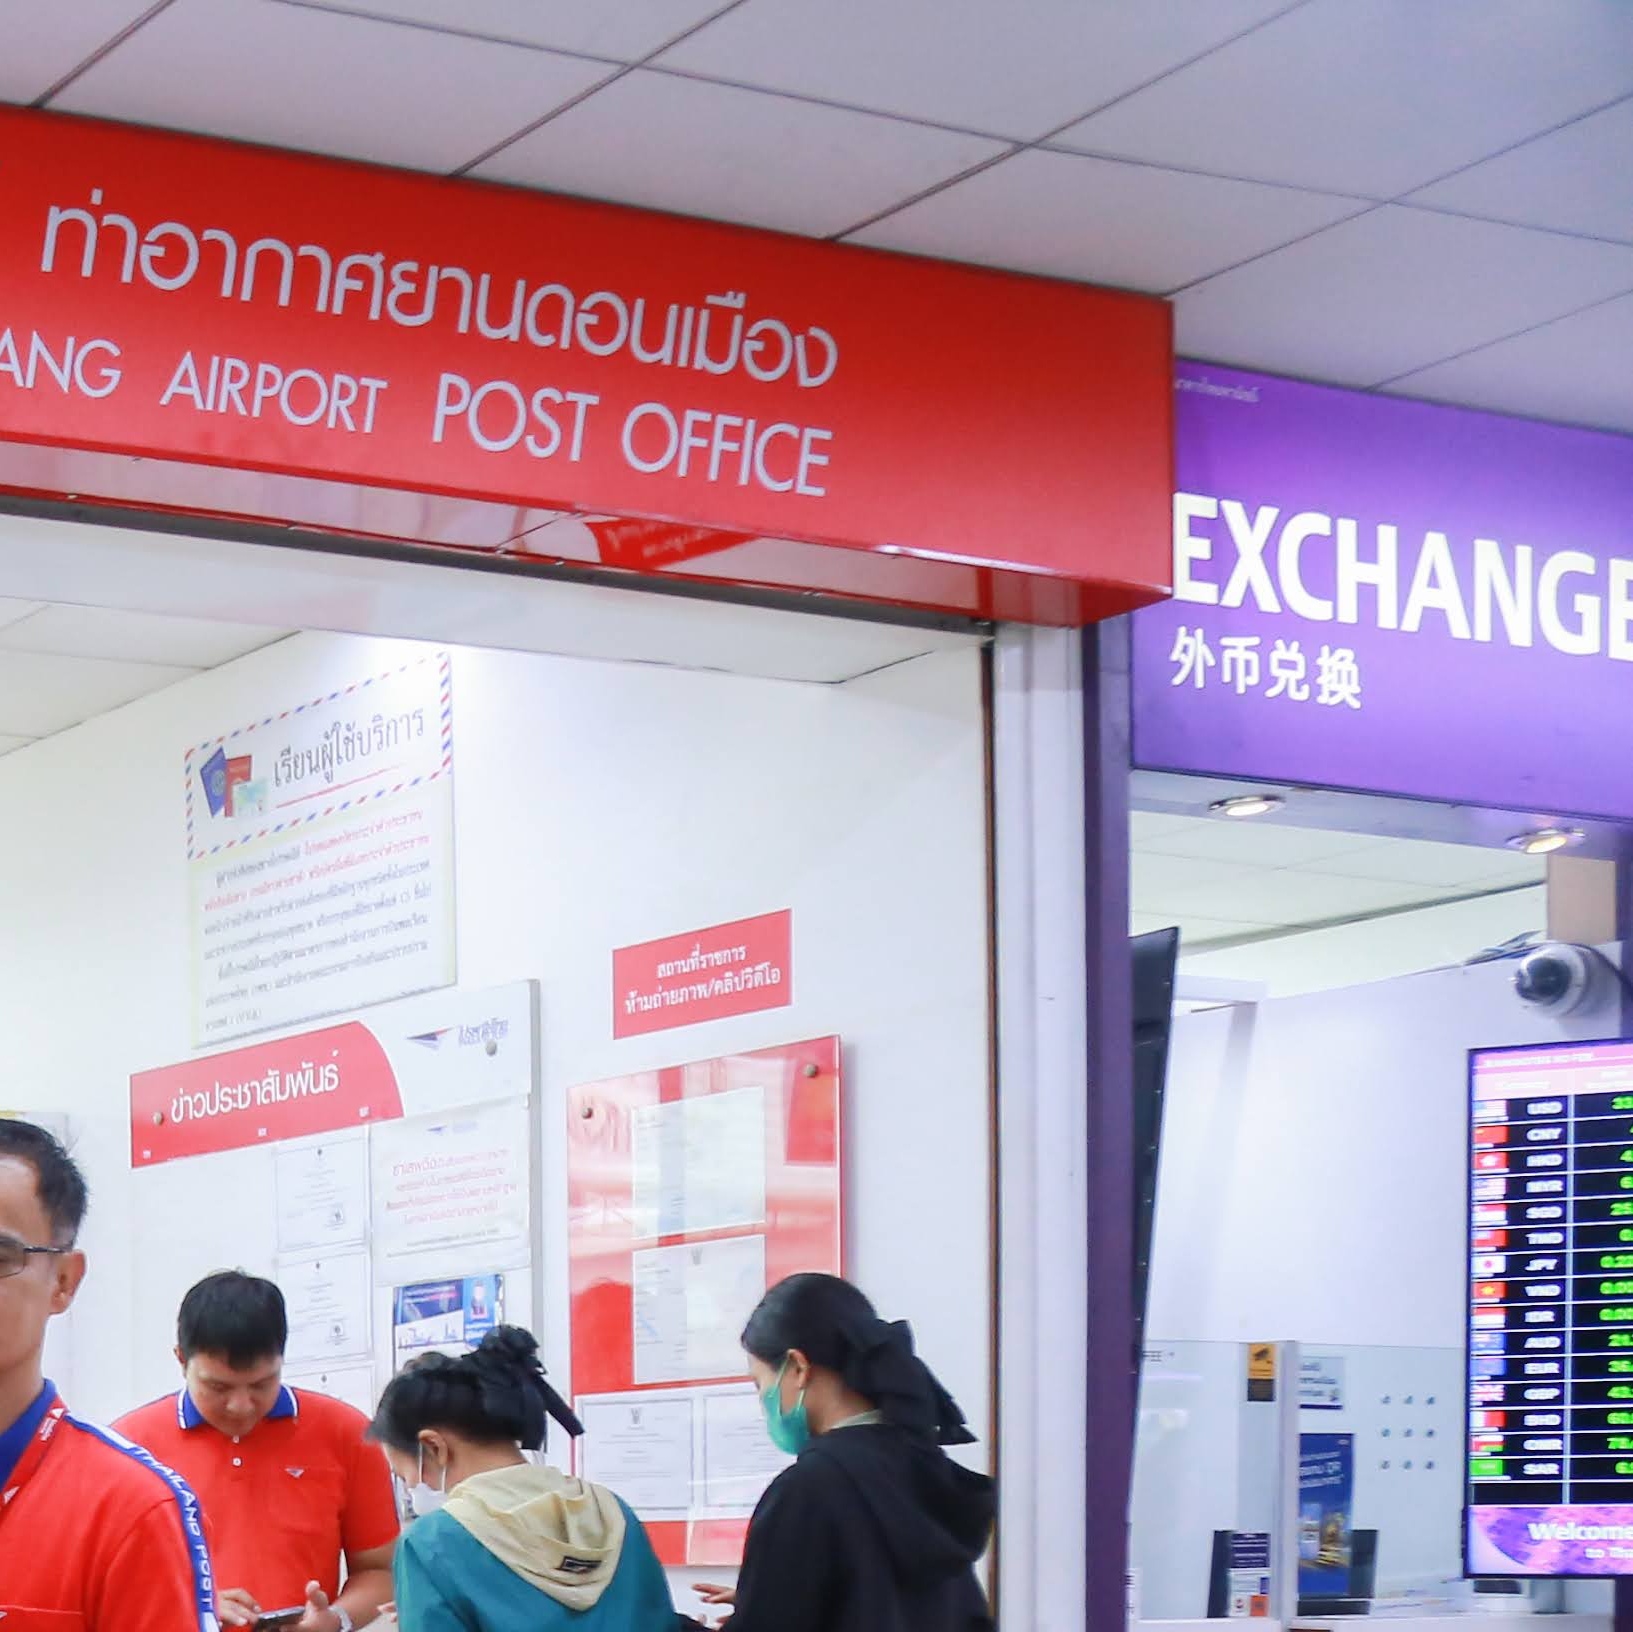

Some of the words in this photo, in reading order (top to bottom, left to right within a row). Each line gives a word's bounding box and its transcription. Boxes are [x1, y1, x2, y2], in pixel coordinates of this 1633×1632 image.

[41, 188, 838, 390] ท่าอากาศยานดอนเมือง
[159, 351, 388, 434] AIRPORT
[432, 373, 600, 463] POST
[621, 402, 833, 498] OFFICE
[1169, 627, 1362, 710] 外币兑换
[272, 708, 425, 786] เรียนผู้ใช้บริการ
[656, 944, 746, 979] สถานที่ราชการ
[171, 1049, 340, 1123] ข่าวประชาสัมพันธ์
[133, 1446, 202, 1538] THAILAND
[193, 1543, 215, 1609] POST
